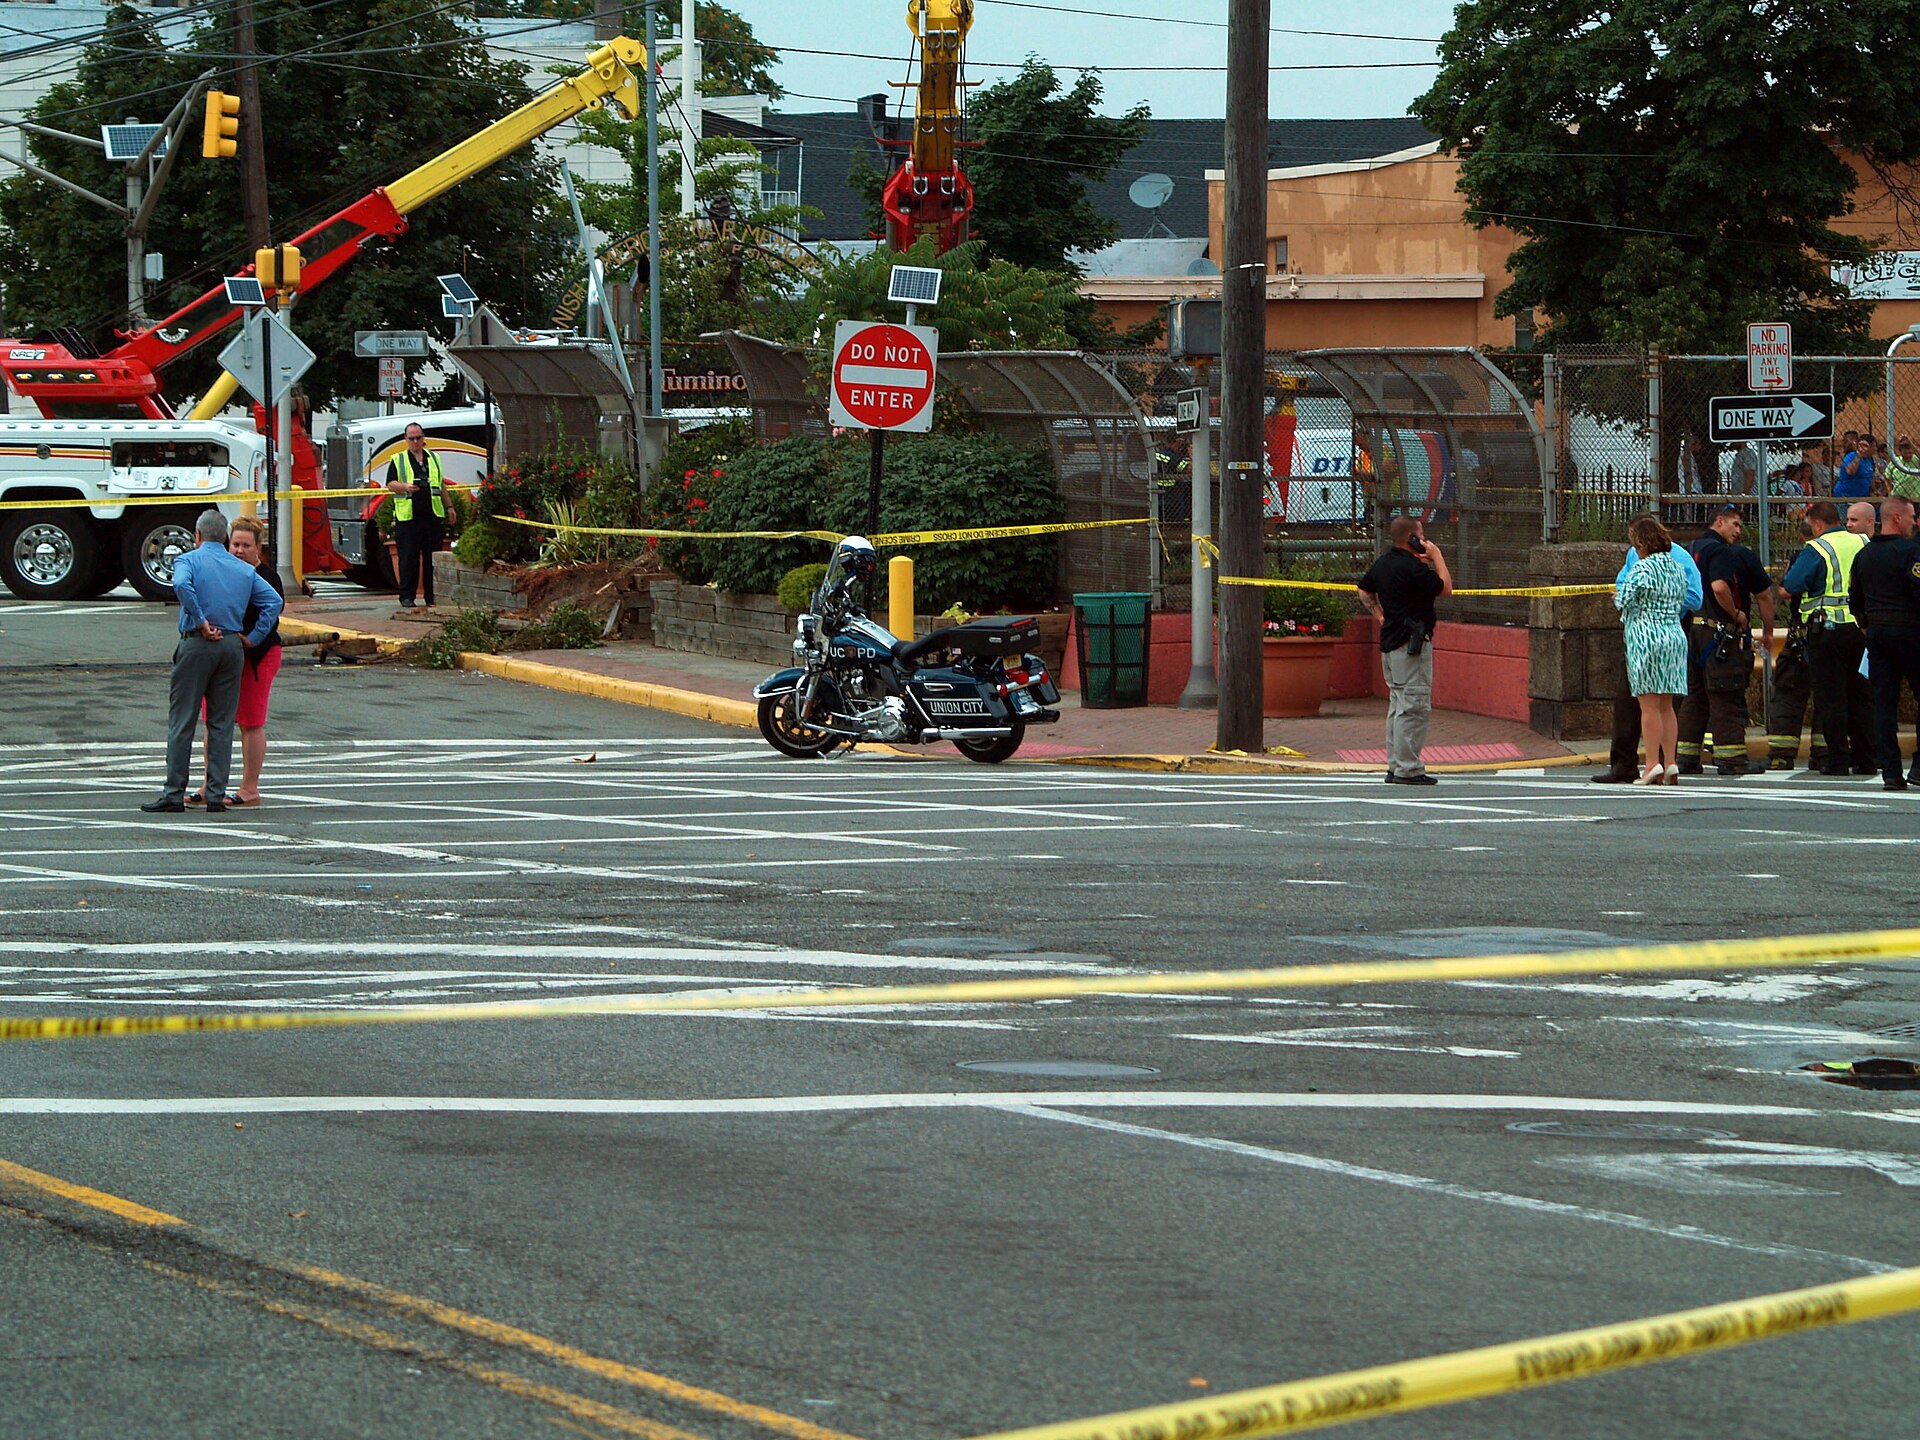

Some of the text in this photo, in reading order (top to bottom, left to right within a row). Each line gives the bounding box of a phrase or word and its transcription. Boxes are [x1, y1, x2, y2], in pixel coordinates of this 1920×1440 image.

[1761, 329, 1776, 342] NO
[376, 339, 418, 349] ONE WAY
[1751, 343, 1788, 356] PARKING
[851, 343, 921, 364] DO NOT
[1761, 357, 1778, 366] ANY
[1760, 367, 1780, 376] TIME
[850, 389, 914, 409] ENTER
[1723, 409, 1795, 428] ONE WAY
[899, 535, 920, 543] CRIME
[933, 533, 957, 541] CROSS
[829, 646, 876, 659] UC PD
[929, 701, 984, 713] UNION CITY
